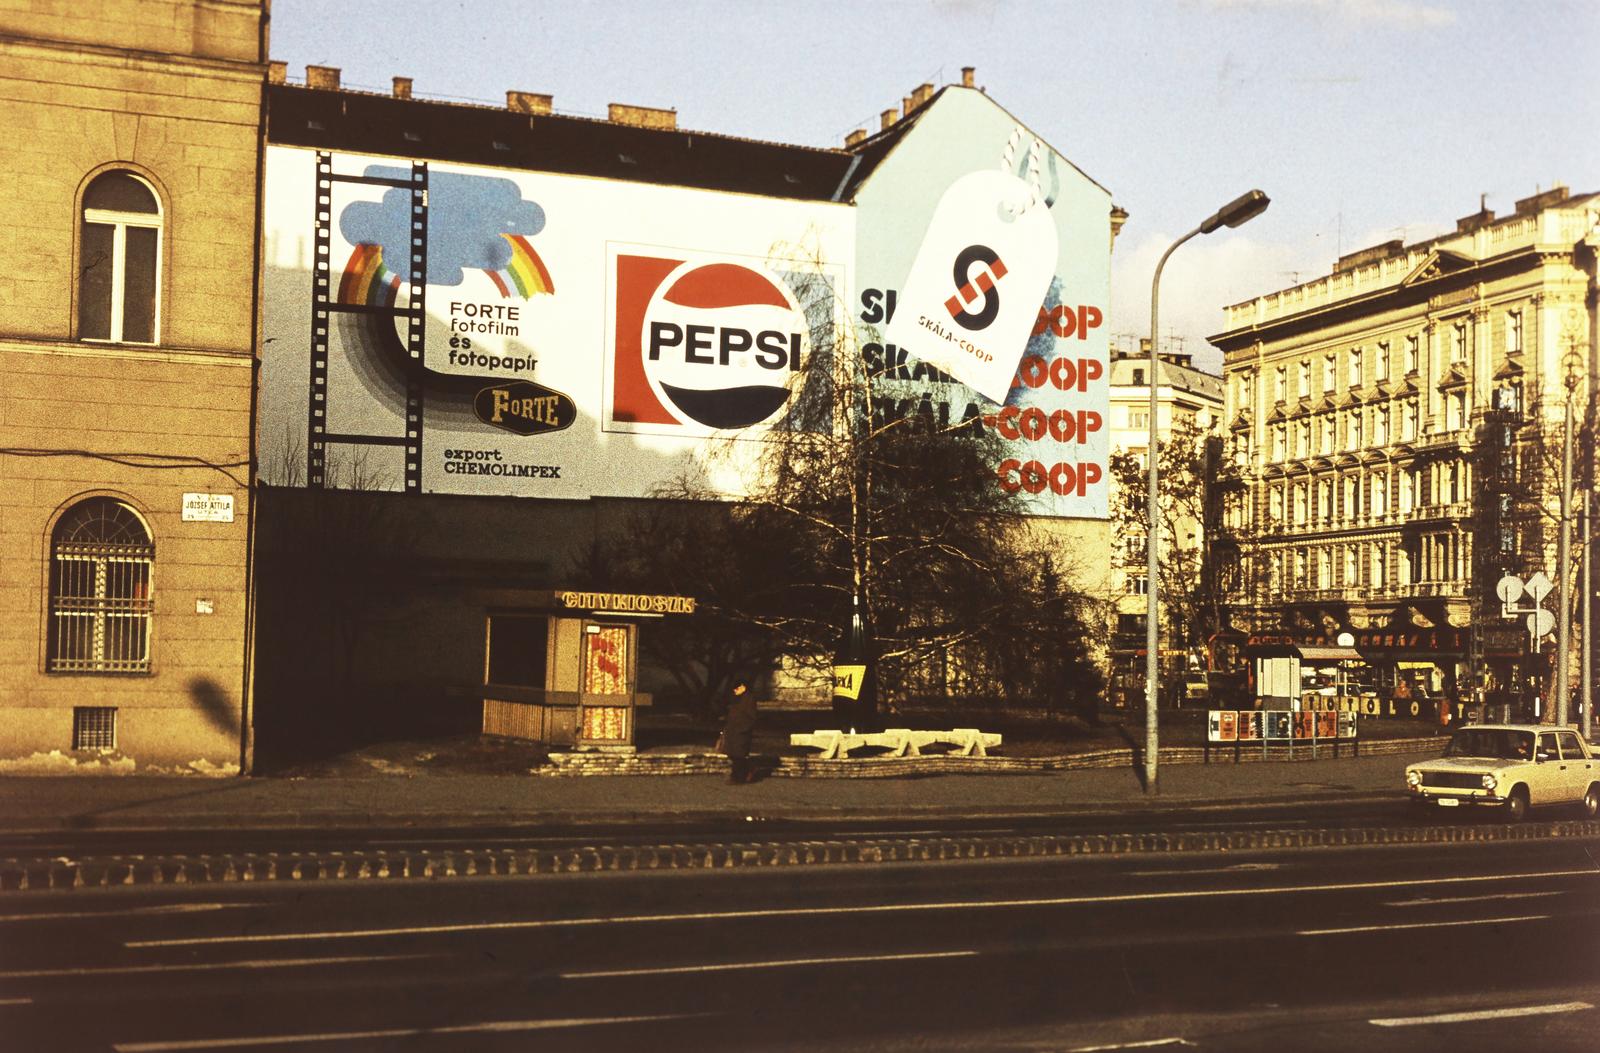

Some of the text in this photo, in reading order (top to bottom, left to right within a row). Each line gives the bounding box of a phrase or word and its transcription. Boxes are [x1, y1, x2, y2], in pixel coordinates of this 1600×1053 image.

[450, 302, 520, 321] FORTE
[451, 319, 519, 336] fotofilm
[449, 334, 471, 350] és
[649, 321, 801, 371] PEPSI
[449, 350, 538, 372] fotopapír
[491, 389, 559, 426] FORTE
[444, 449, 502, 462] export
[444, 462, 561, 478] CHEMOLIMPEX
[210, 501, 230, 510] ATTILA
